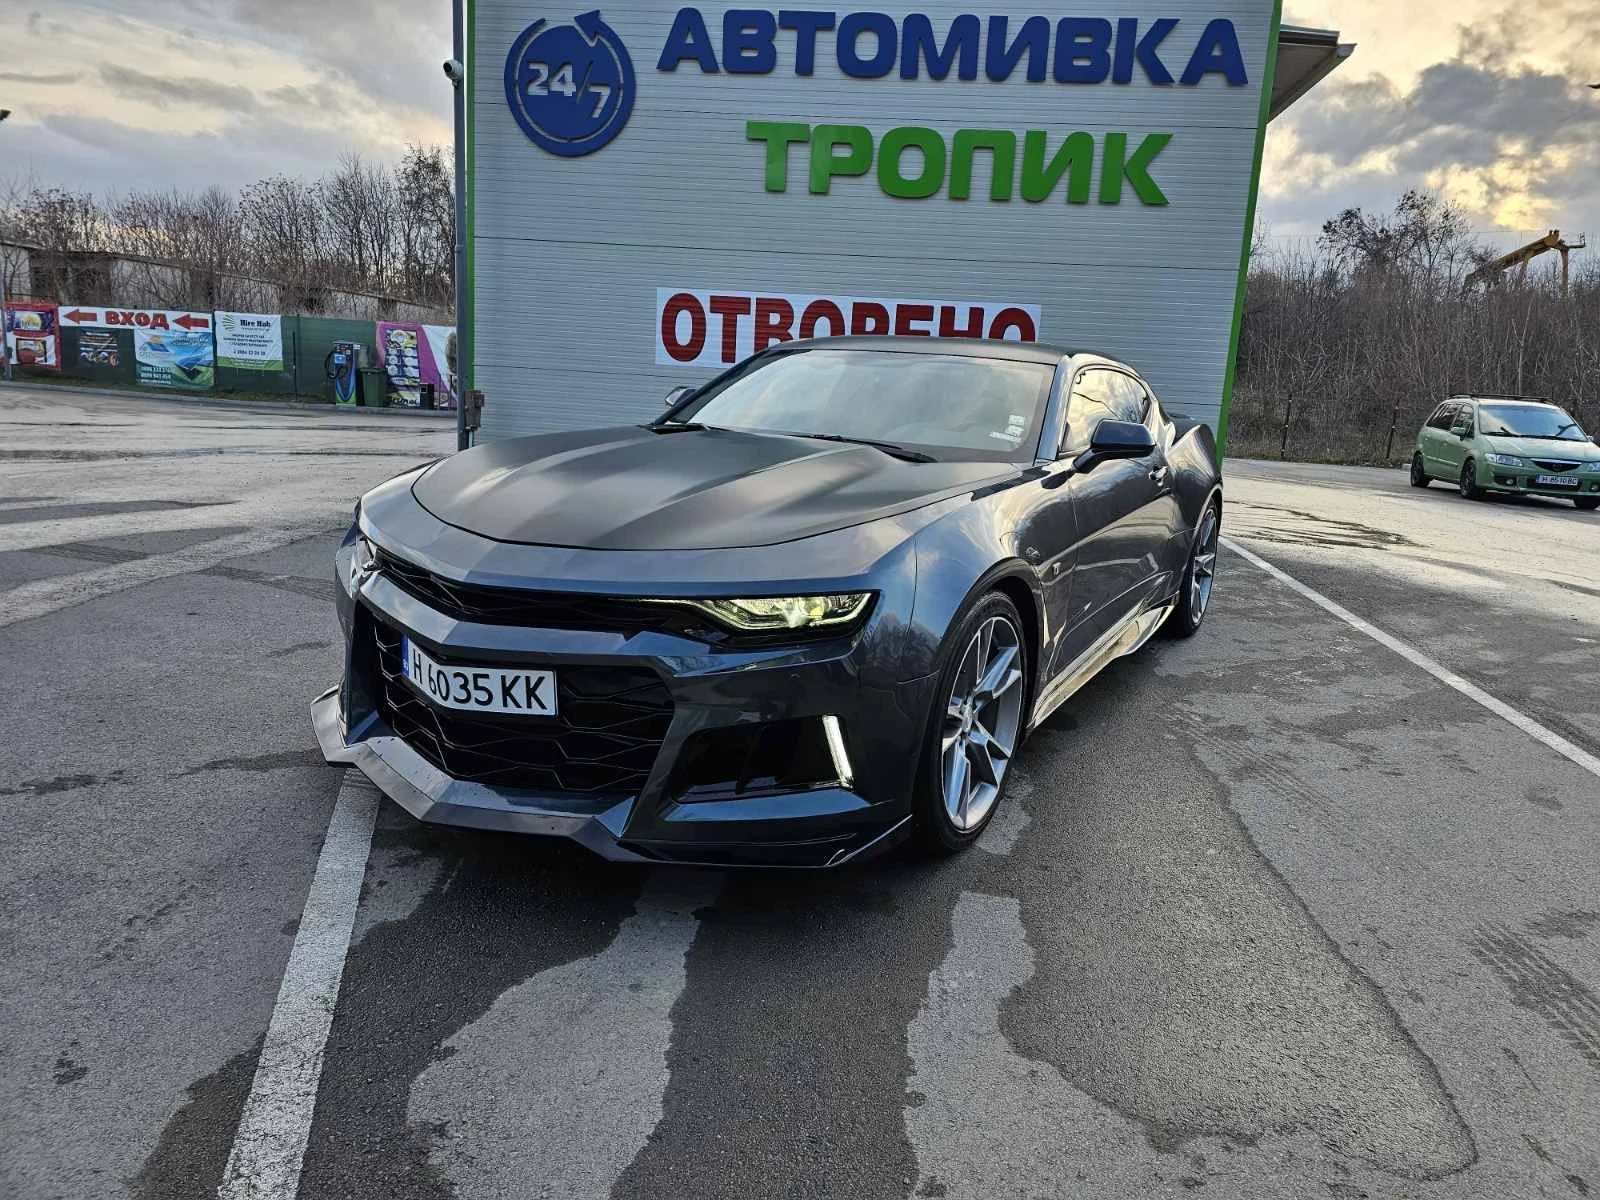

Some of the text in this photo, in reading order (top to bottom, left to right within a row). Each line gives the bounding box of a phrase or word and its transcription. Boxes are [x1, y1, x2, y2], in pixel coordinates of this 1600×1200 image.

[657, 7, 1248, 86] АВТОМИВКА
[526, 59, 612, 120] 24/7
[746, 121, 1174, 206] ТРОПИК
[105, 310, 170, 331] ВХОД
[413, 648, 548, 711] H 6035 KK
